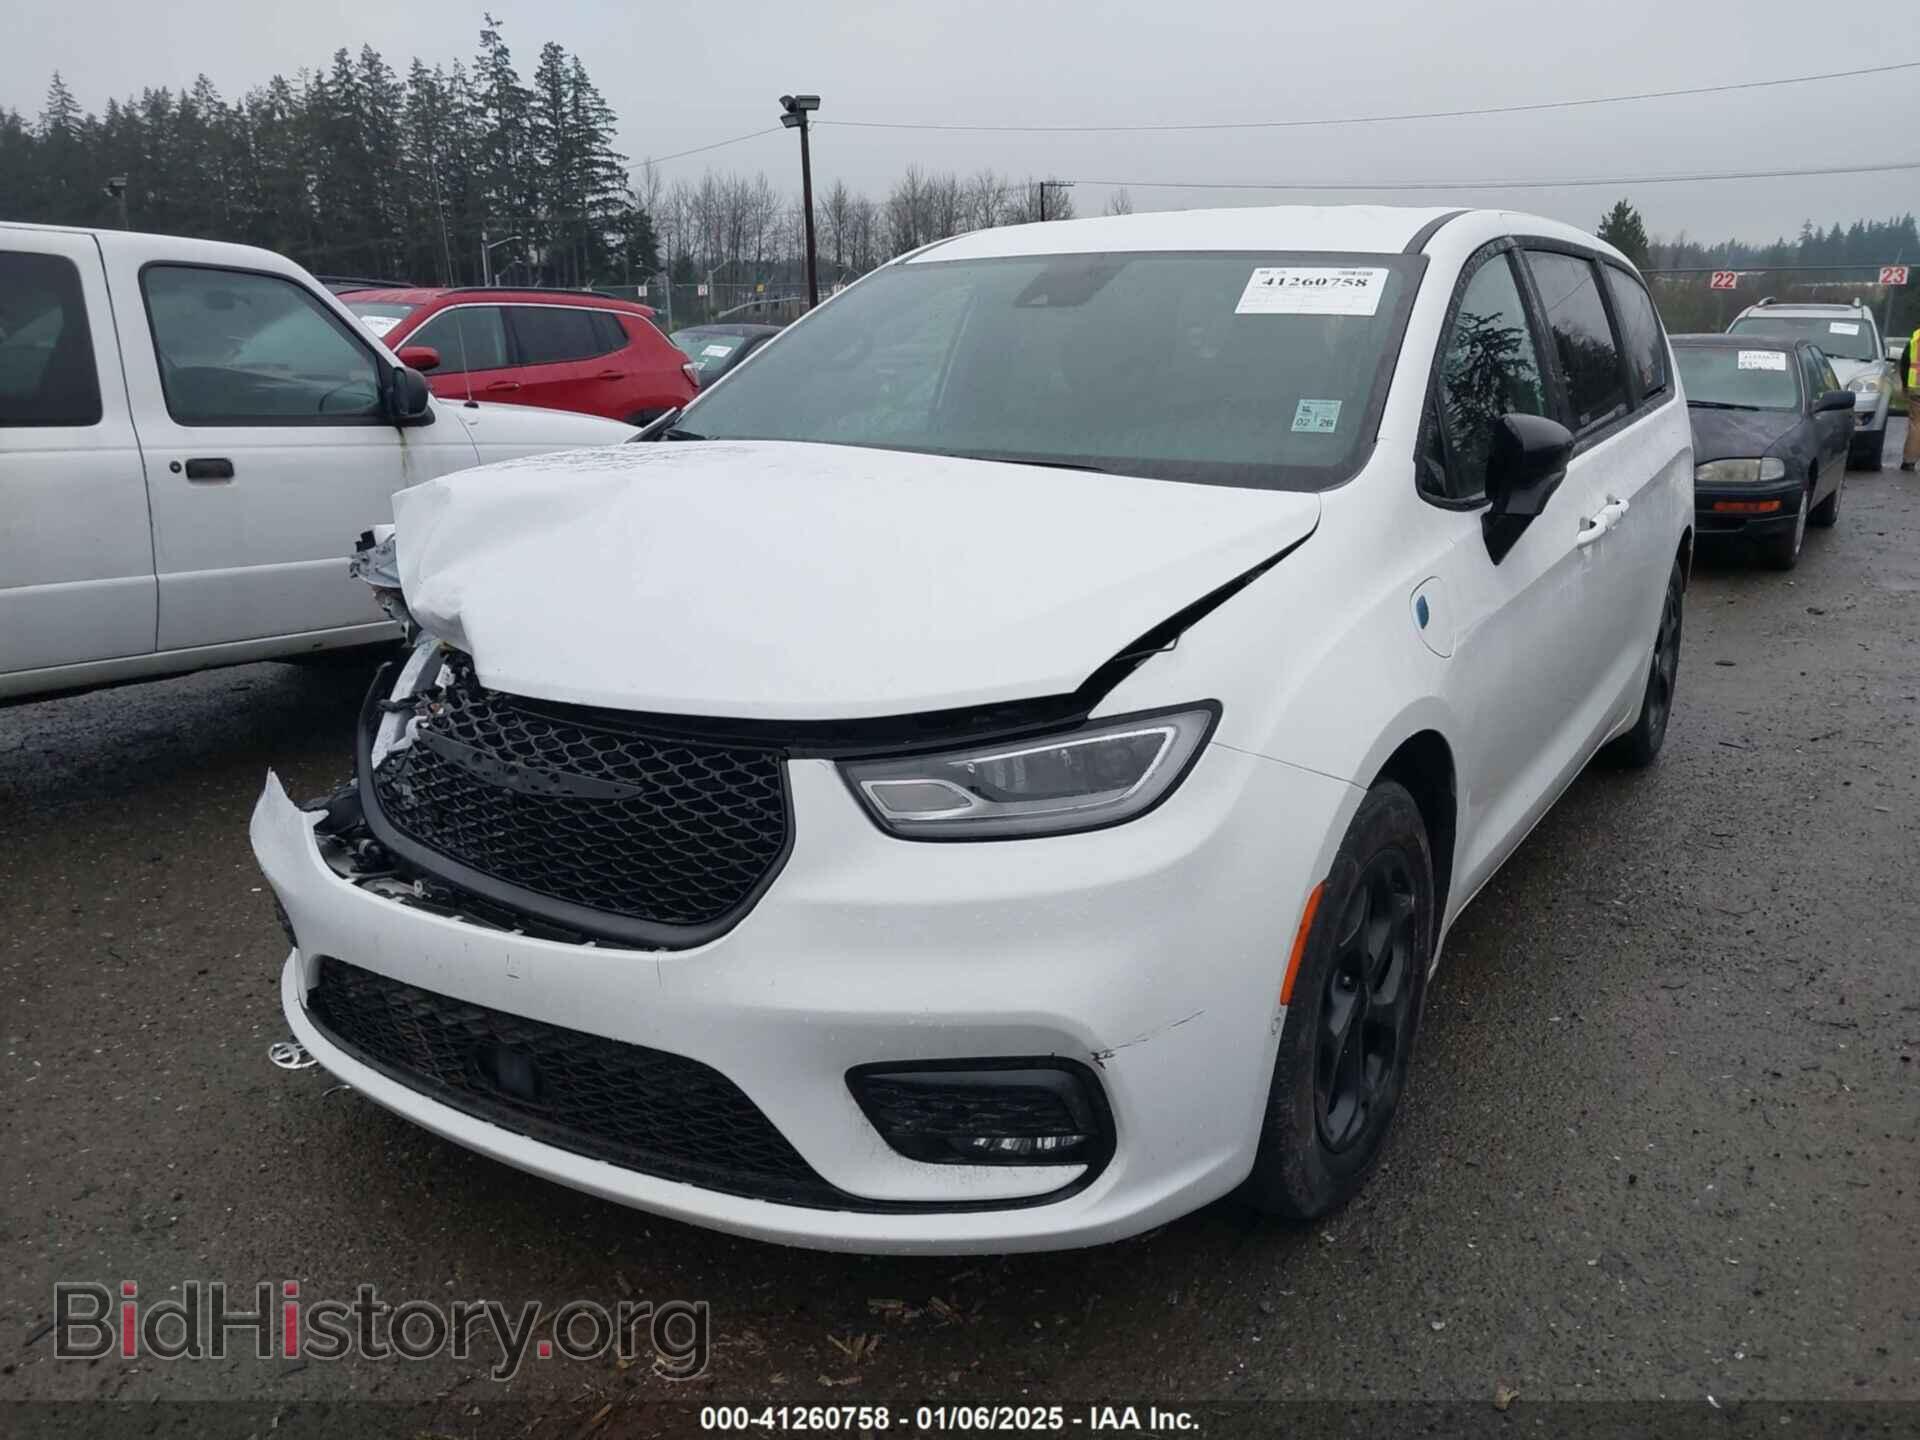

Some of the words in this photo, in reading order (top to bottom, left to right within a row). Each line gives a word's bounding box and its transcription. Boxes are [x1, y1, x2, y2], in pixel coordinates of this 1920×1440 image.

[1261, 277, 1369, 288] 41260758
[1712, 273, 1736, 288] 22
[1881, 267, 1905, 284] 23
